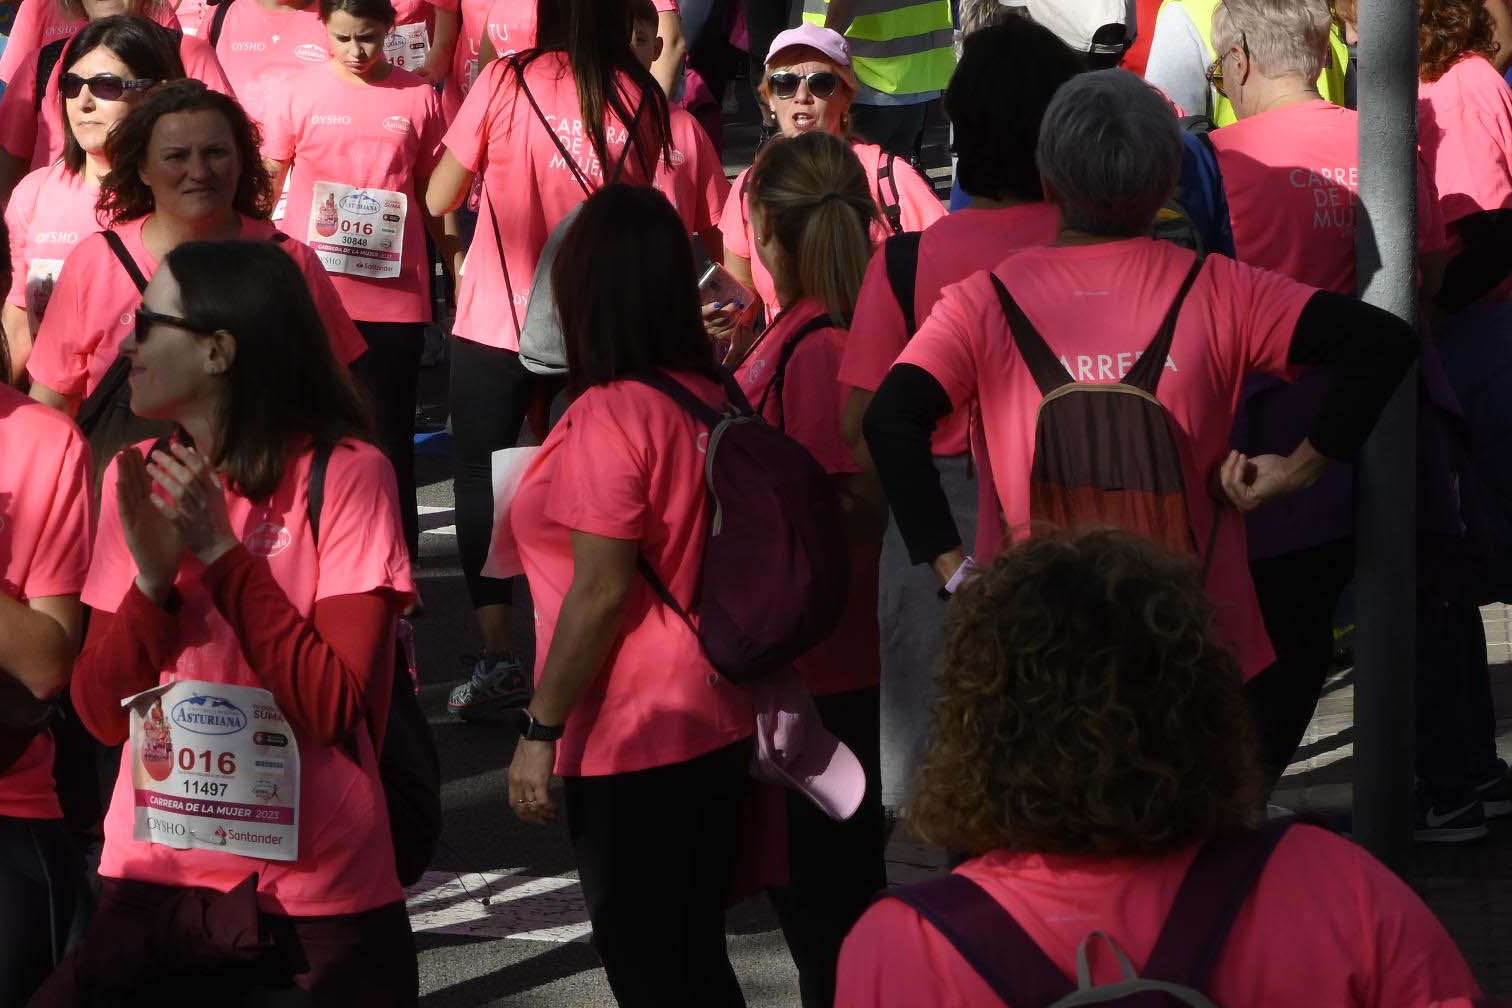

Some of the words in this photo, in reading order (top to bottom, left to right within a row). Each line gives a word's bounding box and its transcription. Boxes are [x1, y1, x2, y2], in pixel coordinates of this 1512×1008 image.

[489, 23, 510, 41] TU
[232, 41, 266, 52] OYSHO
[311, 114, 352, 127] OYSHO
[558, 135, 582, 154] DE
[1313, 187, 1341, 208] DE
[341, 219, 373, 236] 016
[317, 244, 343, 252] CARRERA
[342, 235, 368, 247] 30848
[364, 263, 394, 273] Santander
[176, 708, 241, 727] ASTURIANA
[178, 747, 236, 775] 016
[183, 779, 228, 798] 11497
[149, 796, 184, 810] CARRERA
[186, 802, 200, 812] DE
[202, 804, 214, 814] LA
[216, 806, 251, 817] MUJER
[255, 809, 279, 819] 2023
[146, 817, 186, 837] OYSHO
[228, 829, 283, 845] Santander
